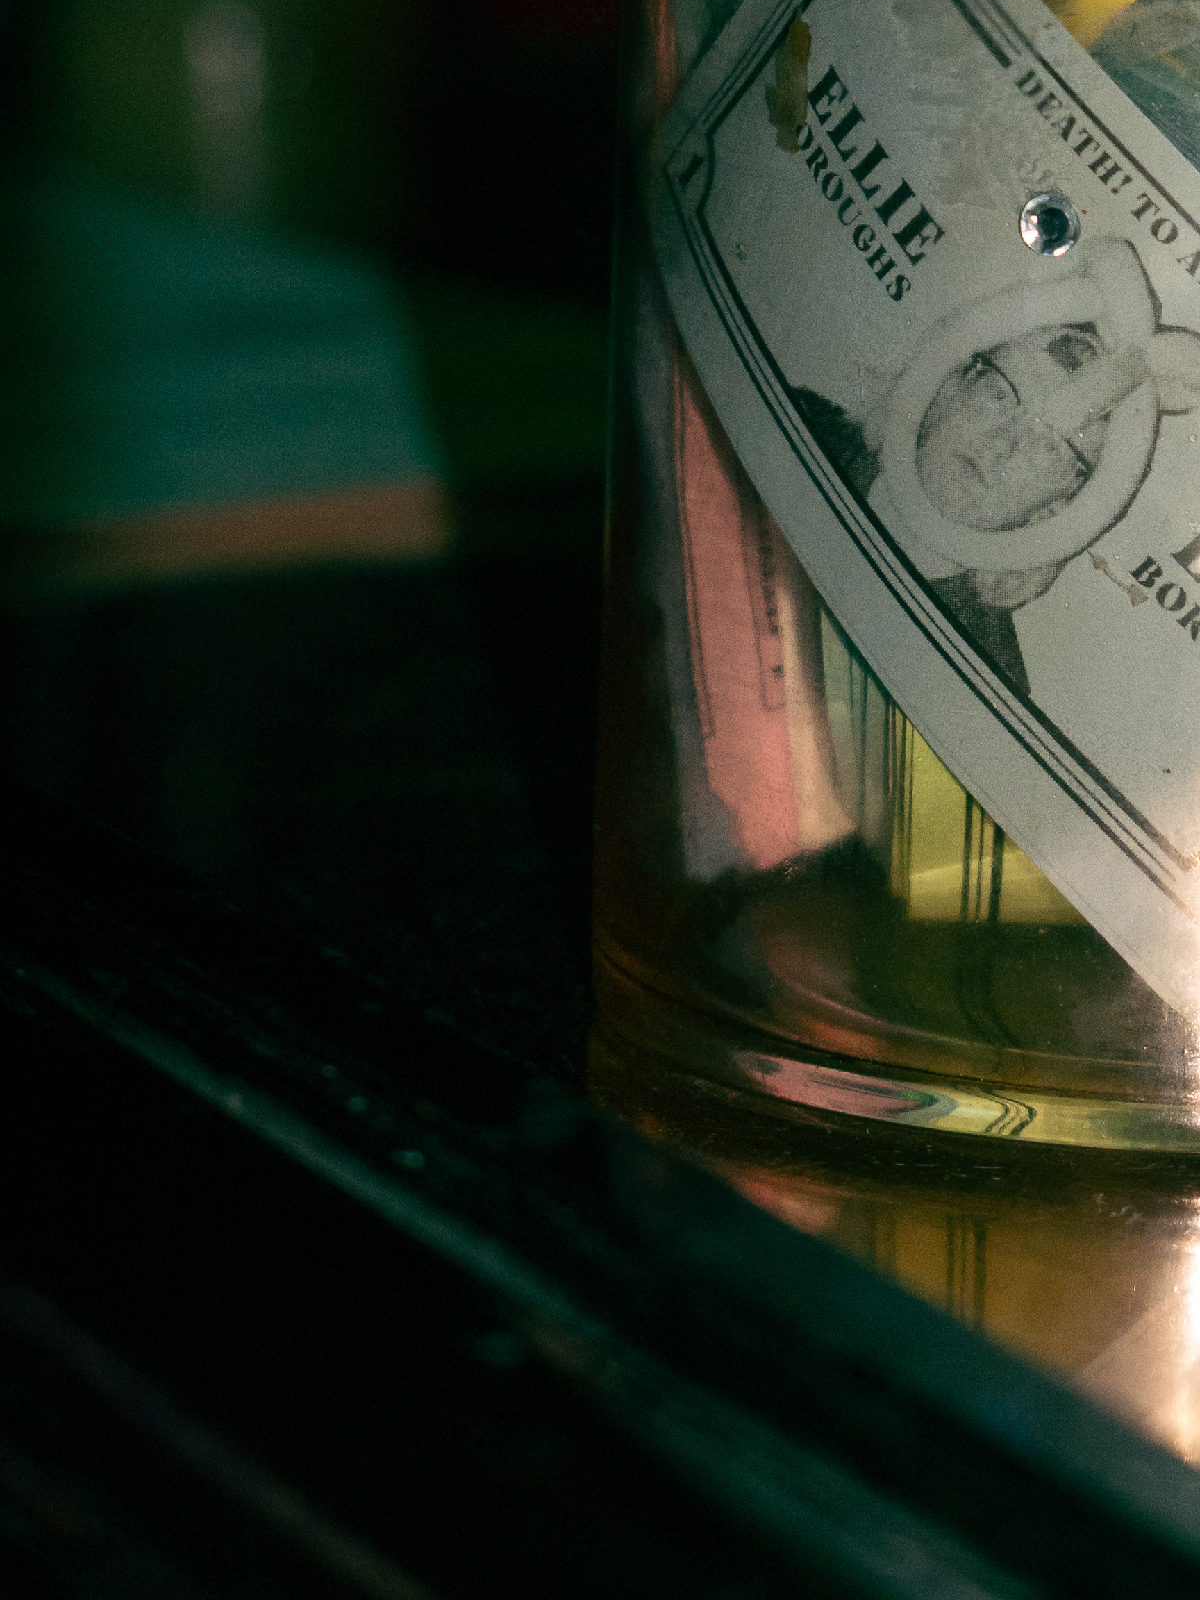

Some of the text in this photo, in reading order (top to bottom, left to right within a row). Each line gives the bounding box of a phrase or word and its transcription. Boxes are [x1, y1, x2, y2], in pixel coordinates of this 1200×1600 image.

[793, 118, 912, 302] OROUGHS
[807, 64, 945, 266] ELLIE
[1015, 70, 1133, 194] DEATH!
[1132, 192, 1178, 245] TO
